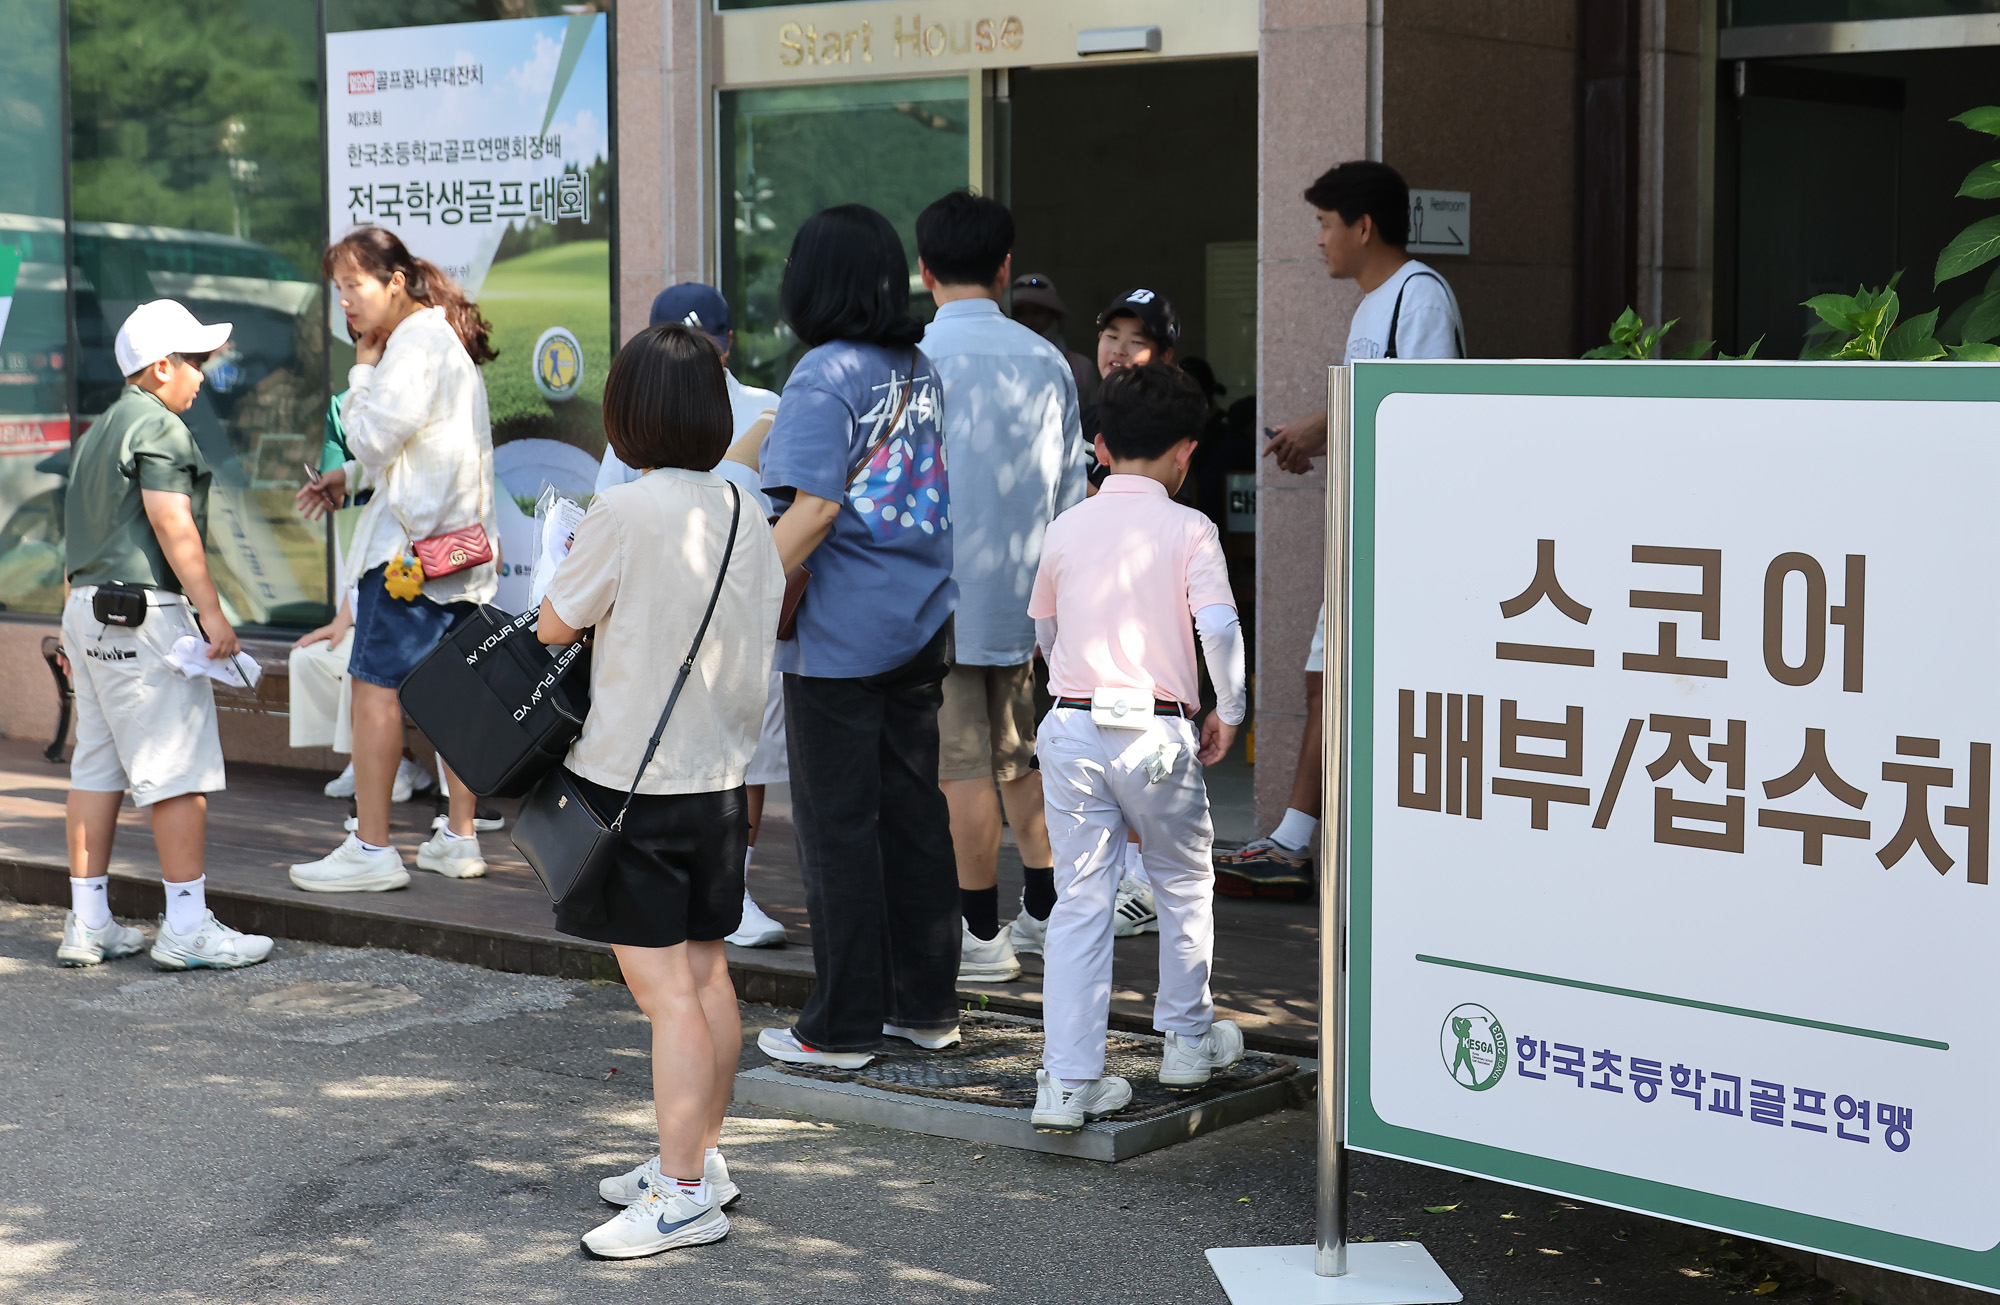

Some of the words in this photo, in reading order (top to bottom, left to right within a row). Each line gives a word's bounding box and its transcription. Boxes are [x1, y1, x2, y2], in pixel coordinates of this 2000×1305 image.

[779, 19, 873, 66] Start
[894, 14, 1024, 58] House
[376, 64, 484, 91] 골프꿈나무대잔치
[348, 110, 382, 127] 제23회
[348, 134, 561, 168] 한국초등학교골프연맹회장배
[347, 172, 590, 227] 전국학생골프대회
[1430, 197, 1467, 212] Restroom
[1496, 539, 1866, 693] 스코어
[466, 650, 479, 666] AY
[478, 624, 515, 653] YOUR
[513, 606, 541, 629] BES
[553, 642, 583, 675] BEST
[530, 672, 556, 705] PLAY
[512, 704, 532, 721] YO
[1398, 688, 1992, 885] 배부/접수처
[1462, 1036, 1494, 1054] KESGA
[1492, 1025, 1506, 1055] 2003
[1491, 1056, 1506, 1081] SINCE
[1516, 1035, 1913, 1153] 한국초등학교골프연맹
